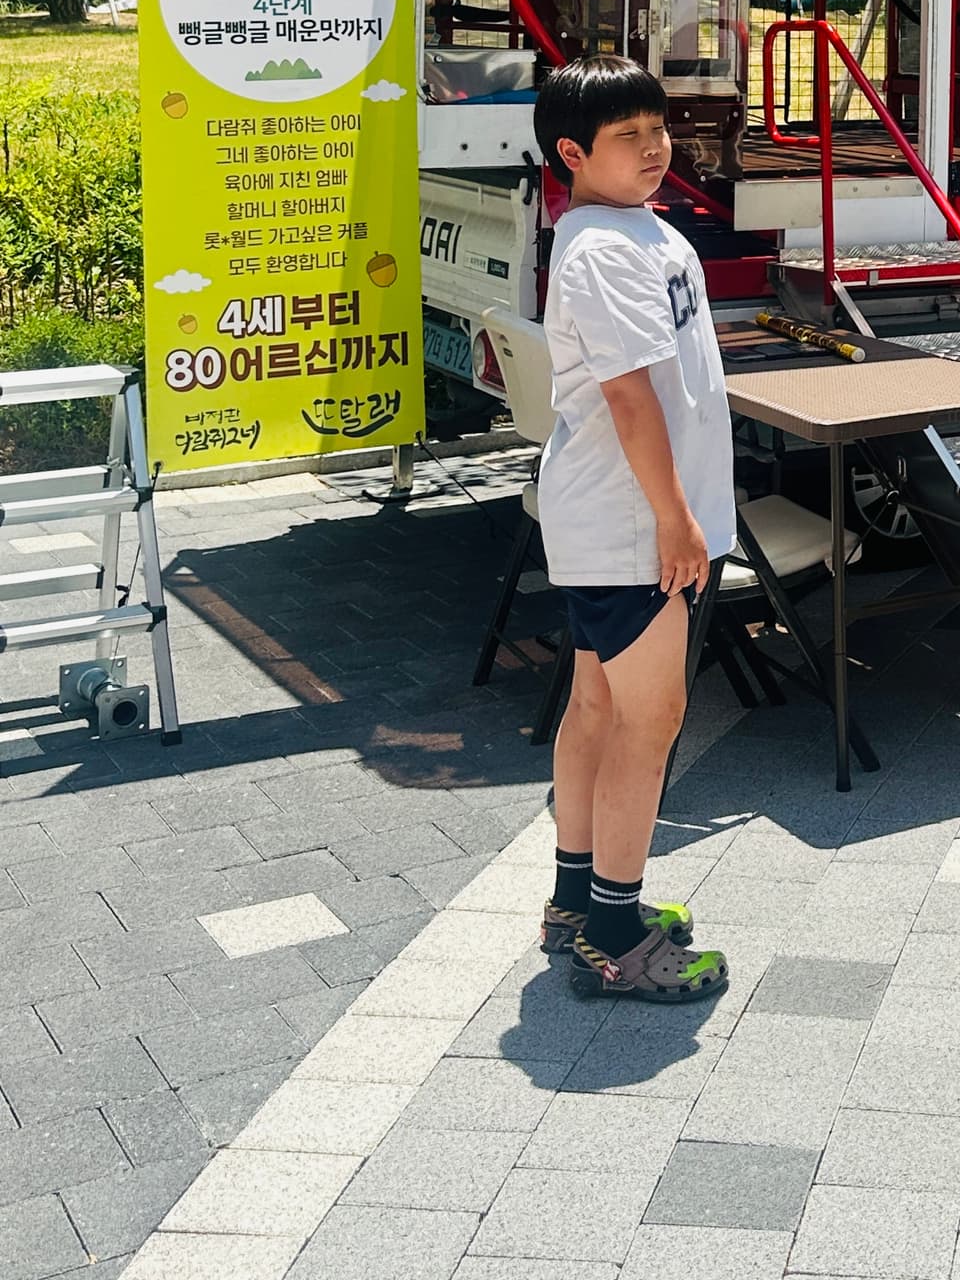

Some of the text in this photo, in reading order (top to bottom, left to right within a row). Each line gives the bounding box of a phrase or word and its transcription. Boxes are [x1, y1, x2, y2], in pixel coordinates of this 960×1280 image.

[178, 18, 383, 46] 뺑글뺑글 매운맛까지
[207, 114, 361, 137] 다람쥐 좋아하는 아이
[216, 142, 354, 164] 그네 좋아하는 아이
[225, 169, 348, 192] 육아에 지친 엄빠
[227, 196, 345, 221] 할머니 할아버지
[268, 224, 332, 245] 가고싶은
[337, 222, 368, 240] 커플
[229, 251, 348, 276] 모두 환영합니다
[217, 290, 360, 338] 4세부터
[165, 331, 409, 392] 80어르신까지
[175, 420, 260, 455] 다람쥐그네
